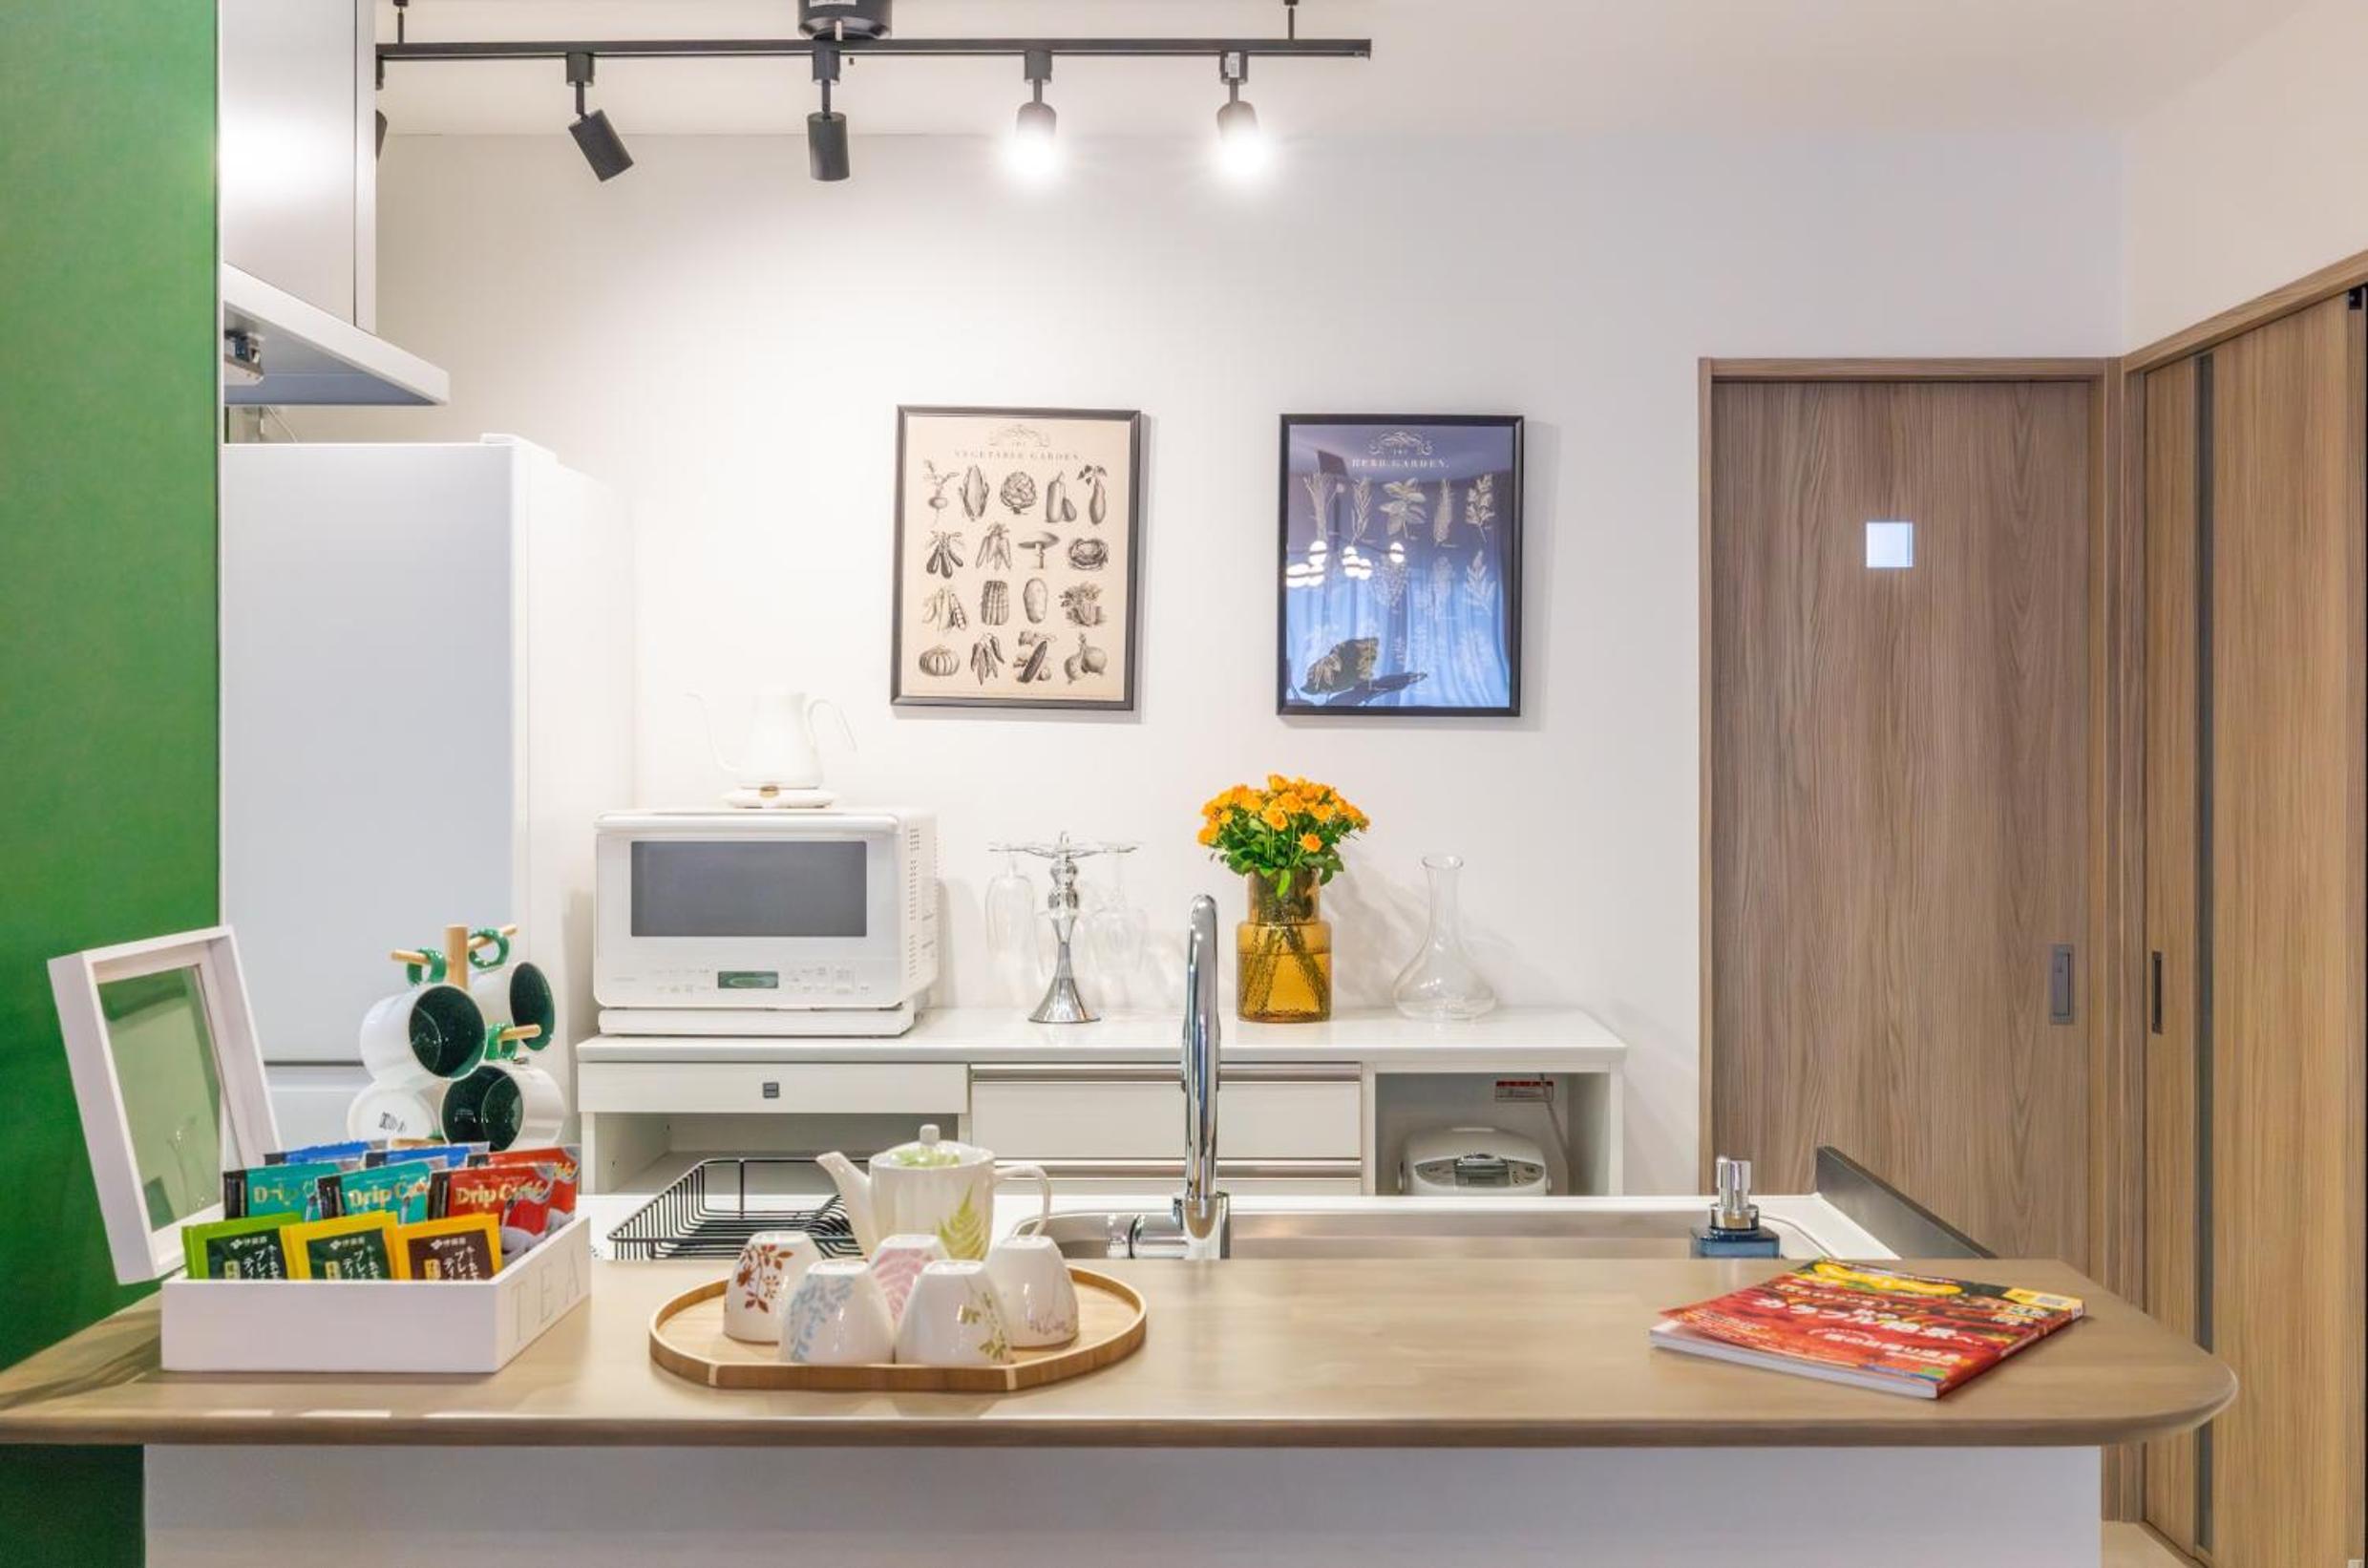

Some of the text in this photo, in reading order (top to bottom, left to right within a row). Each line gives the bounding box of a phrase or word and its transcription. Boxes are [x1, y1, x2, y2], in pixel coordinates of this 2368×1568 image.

[954, 450, 1025, 459] VEGETABLE
[455, 1184, 497, 1209] Drip
[510, 1246, 582, 1343] TEA
